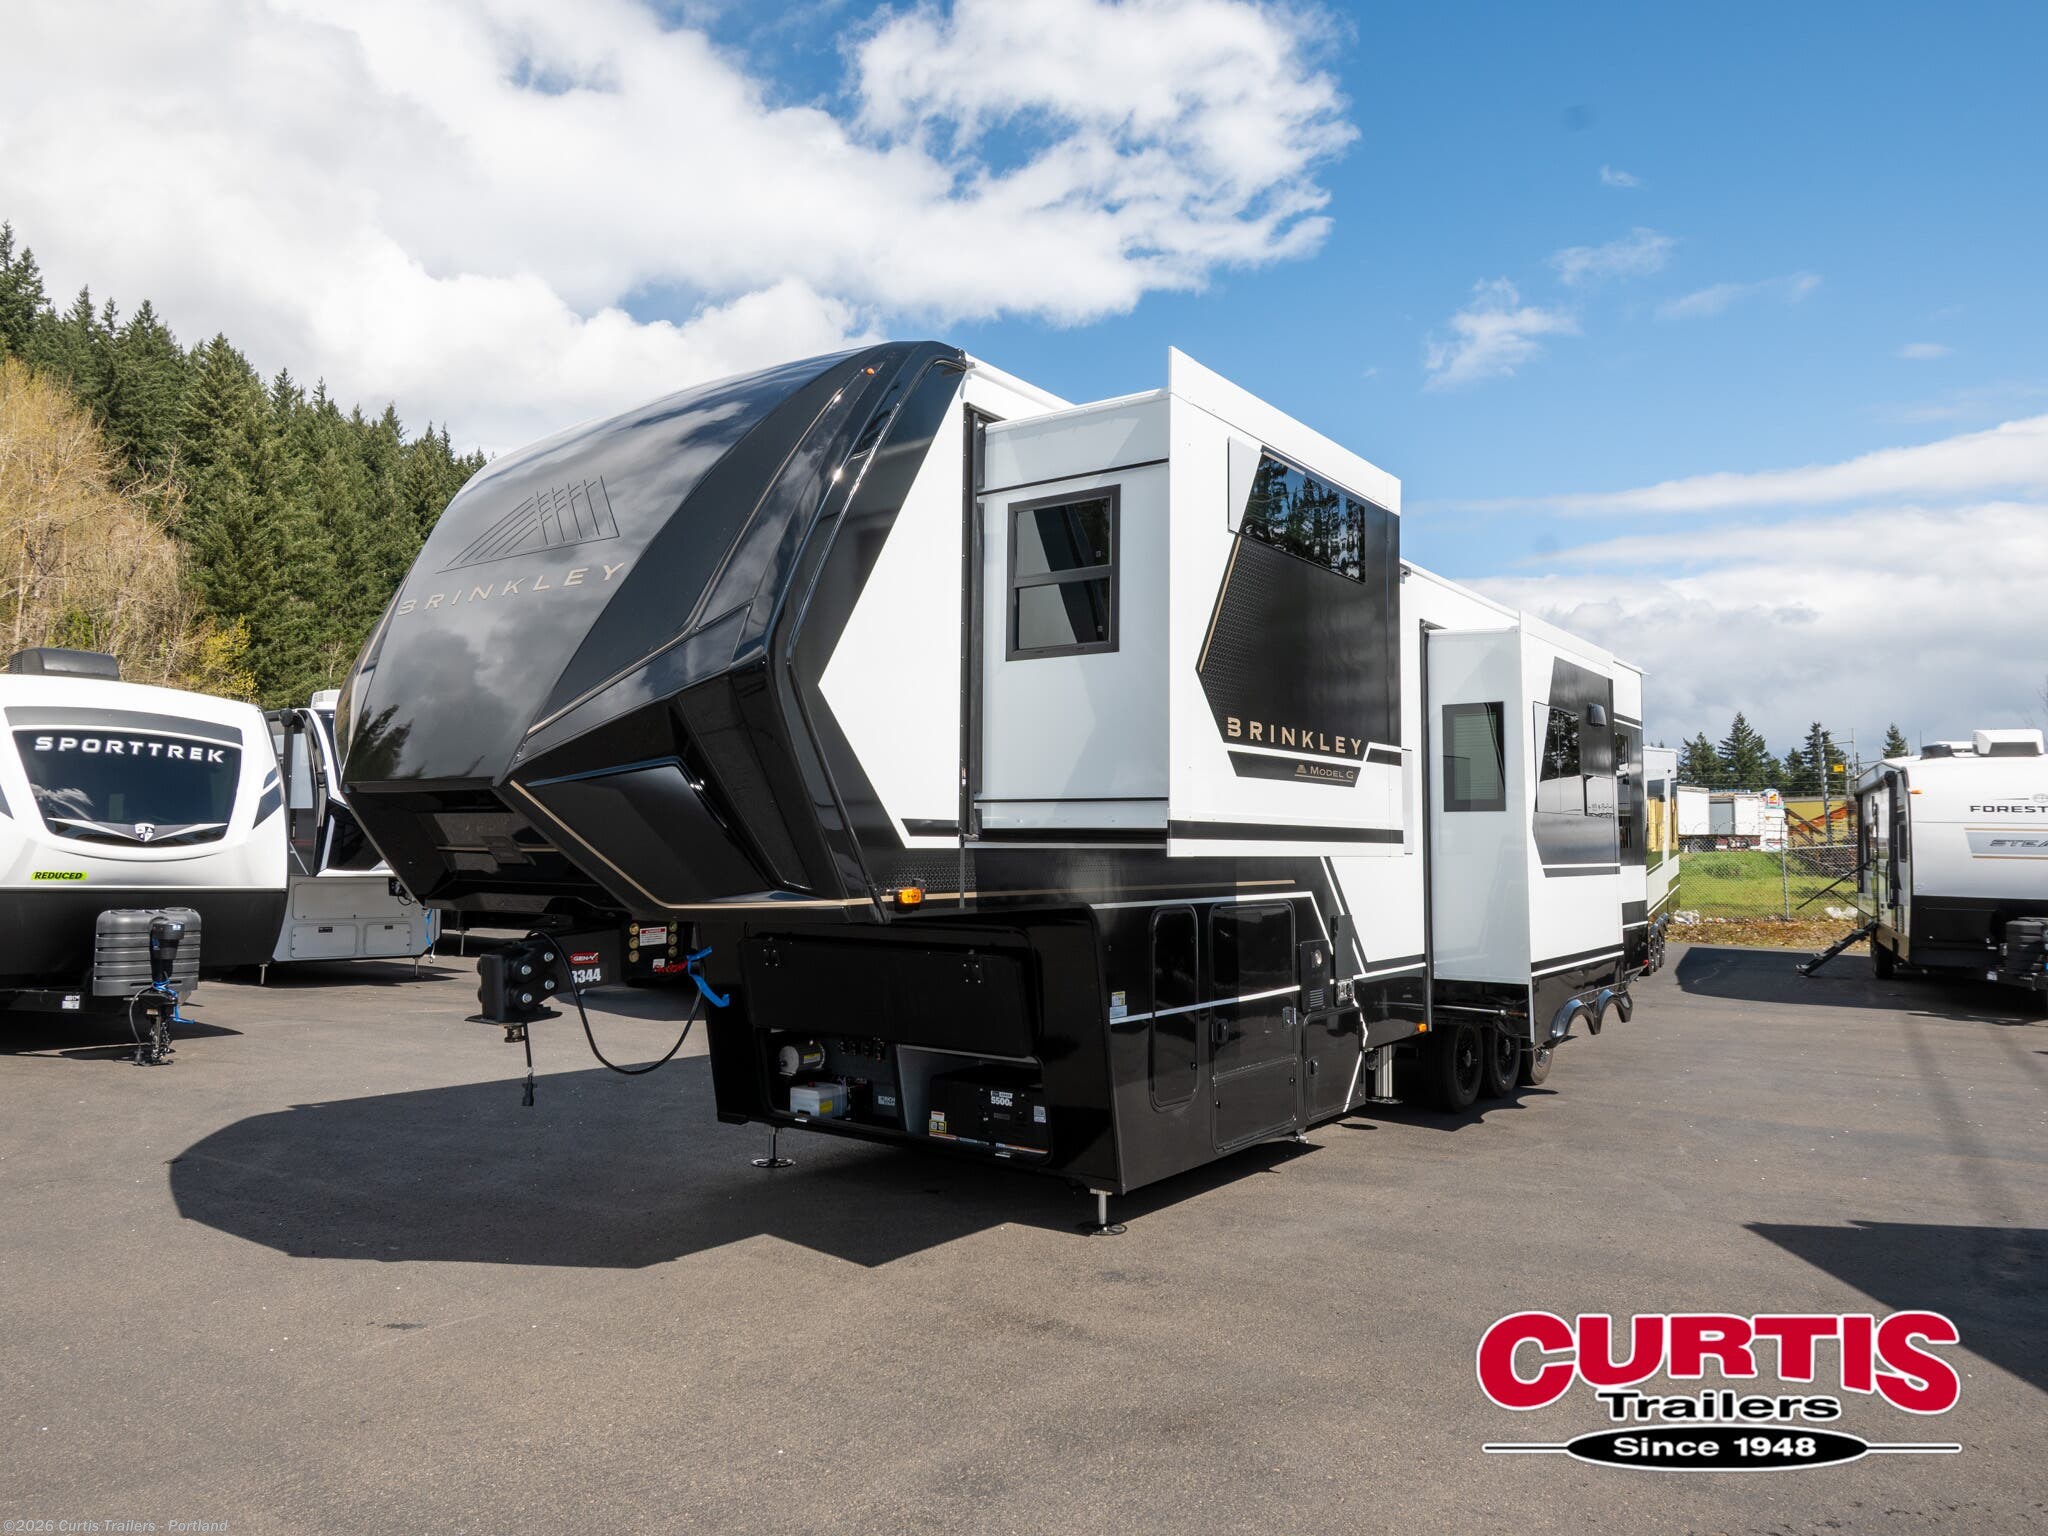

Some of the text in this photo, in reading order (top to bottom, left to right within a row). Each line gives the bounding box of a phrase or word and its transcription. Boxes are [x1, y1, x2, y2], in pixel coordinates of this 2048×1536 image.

[397, 562, 625, 616] BRINKLEY
[1227, 716, 1362, 756] BRINKLEY
[34, 735, 225, 764] SPORTTREK
[1346, 770, 1354, 779] G
[1969, 804, 2048, 813] FOREST
[34, 871, 83, 880] REDUCED
